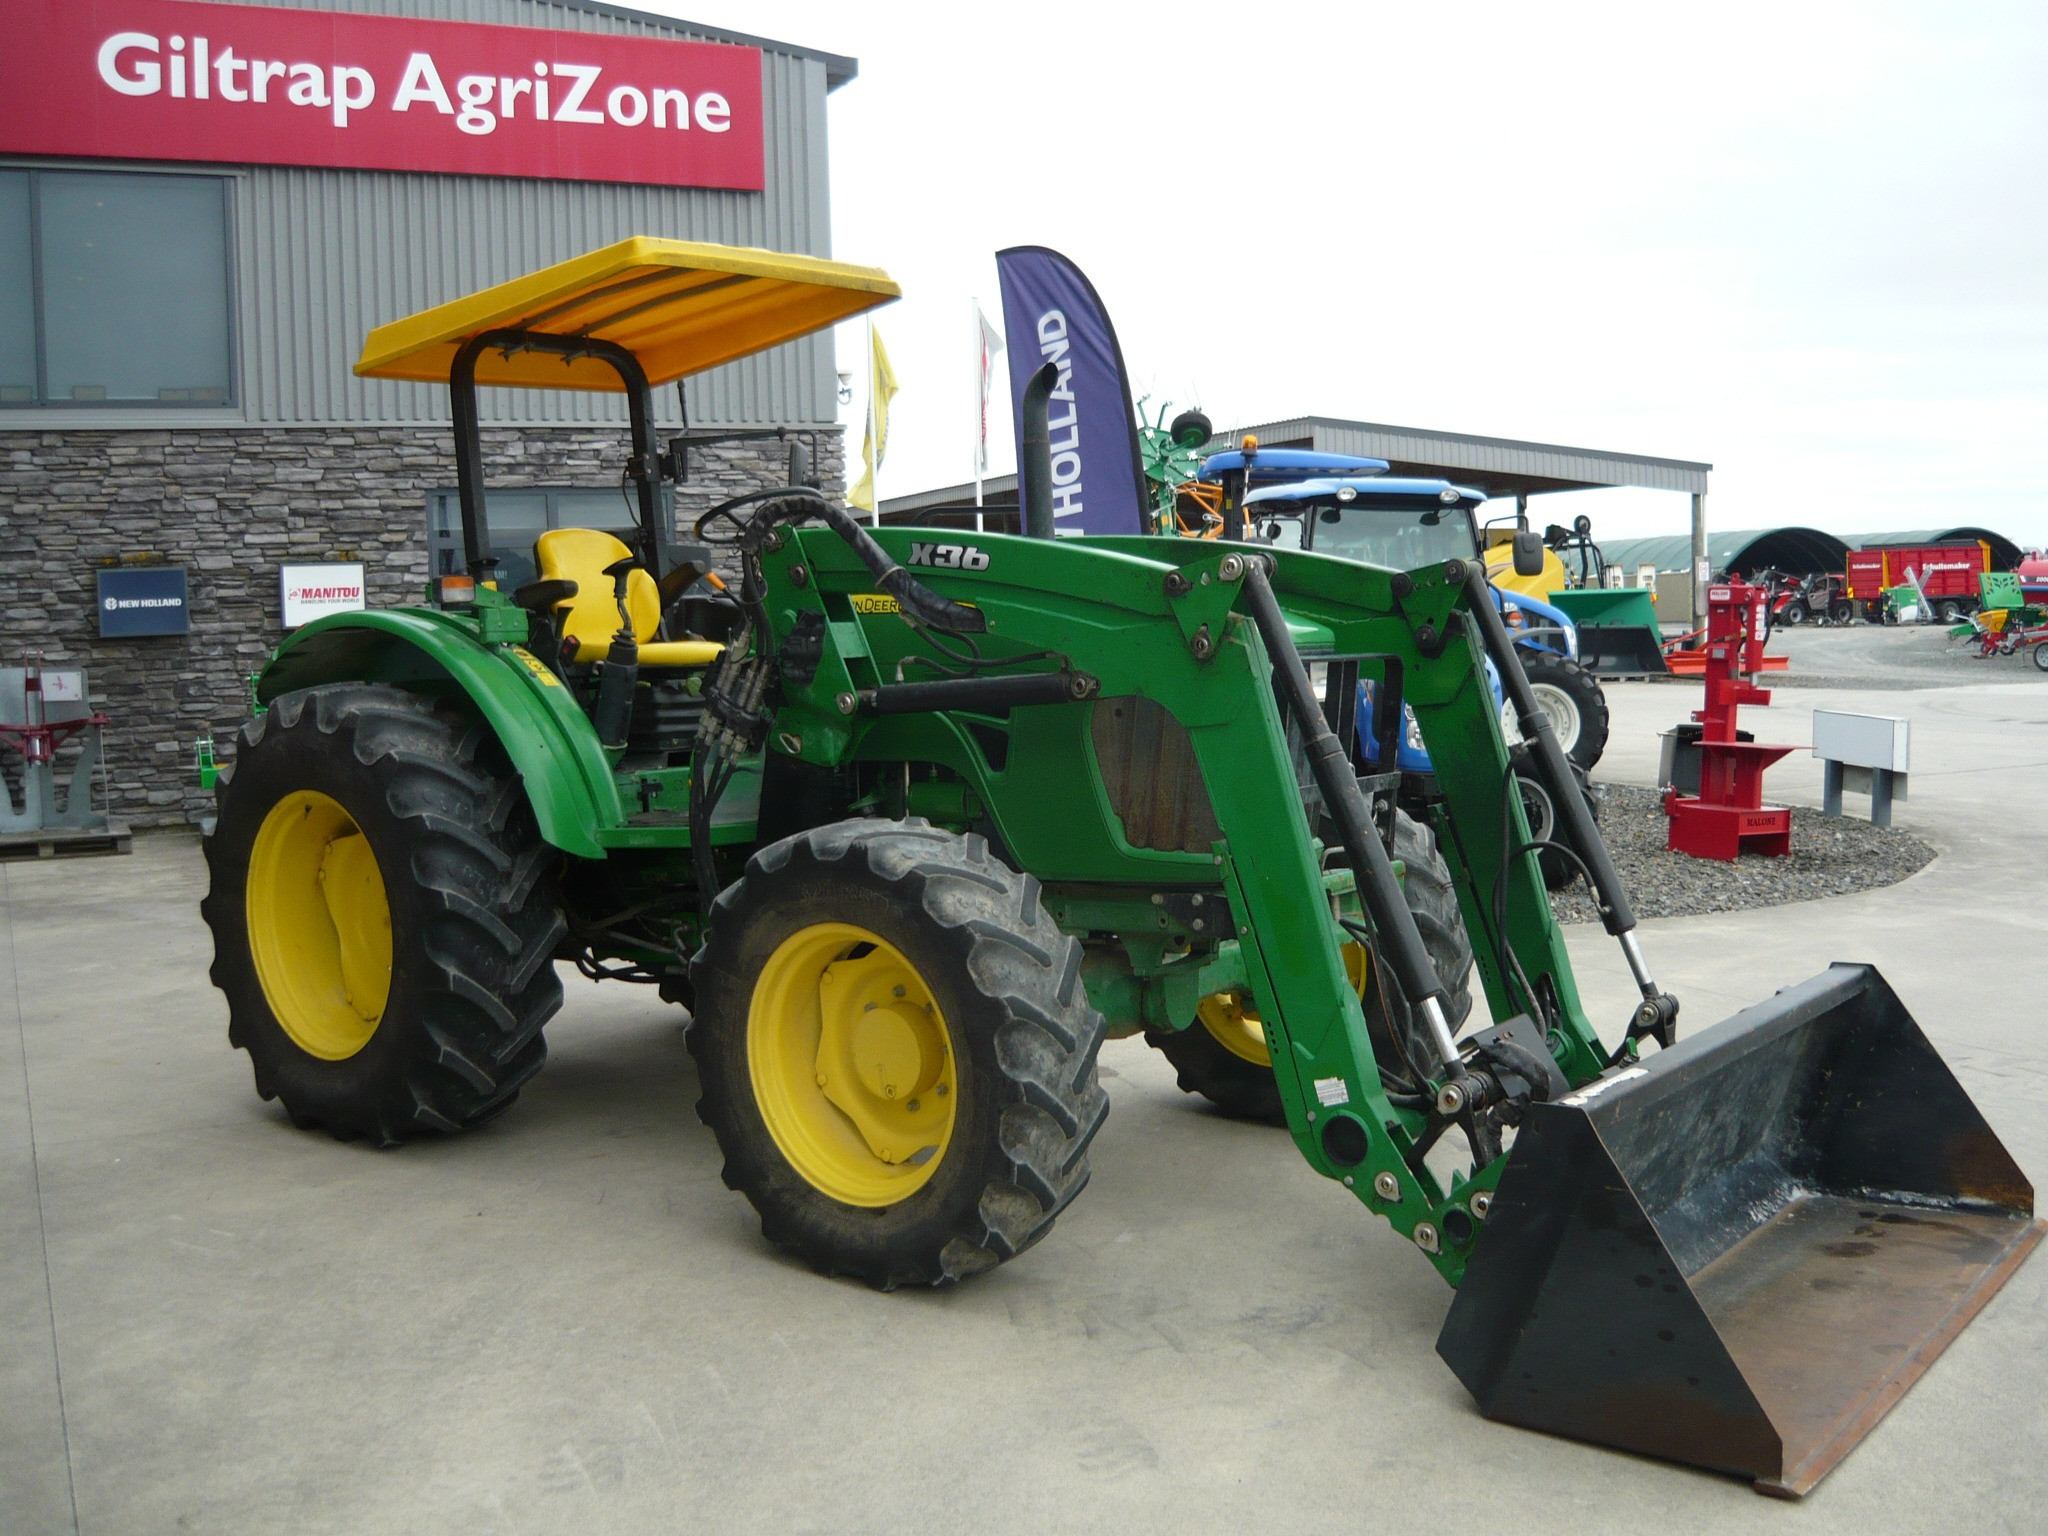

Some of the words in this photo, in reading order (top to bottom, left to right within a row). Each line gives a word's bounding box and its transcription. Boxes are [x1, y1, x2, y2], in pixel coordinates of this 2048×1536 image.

[98, 32, 375, 127] Giltrap
[392, 53, 731, 136] AgriZone
[907, 542, 990, 571] X36
[118, 600, 140, 609] NEW
[141, 597, 182, 608] HOLLAND
[301, 587, 360, 599] MANITOU
